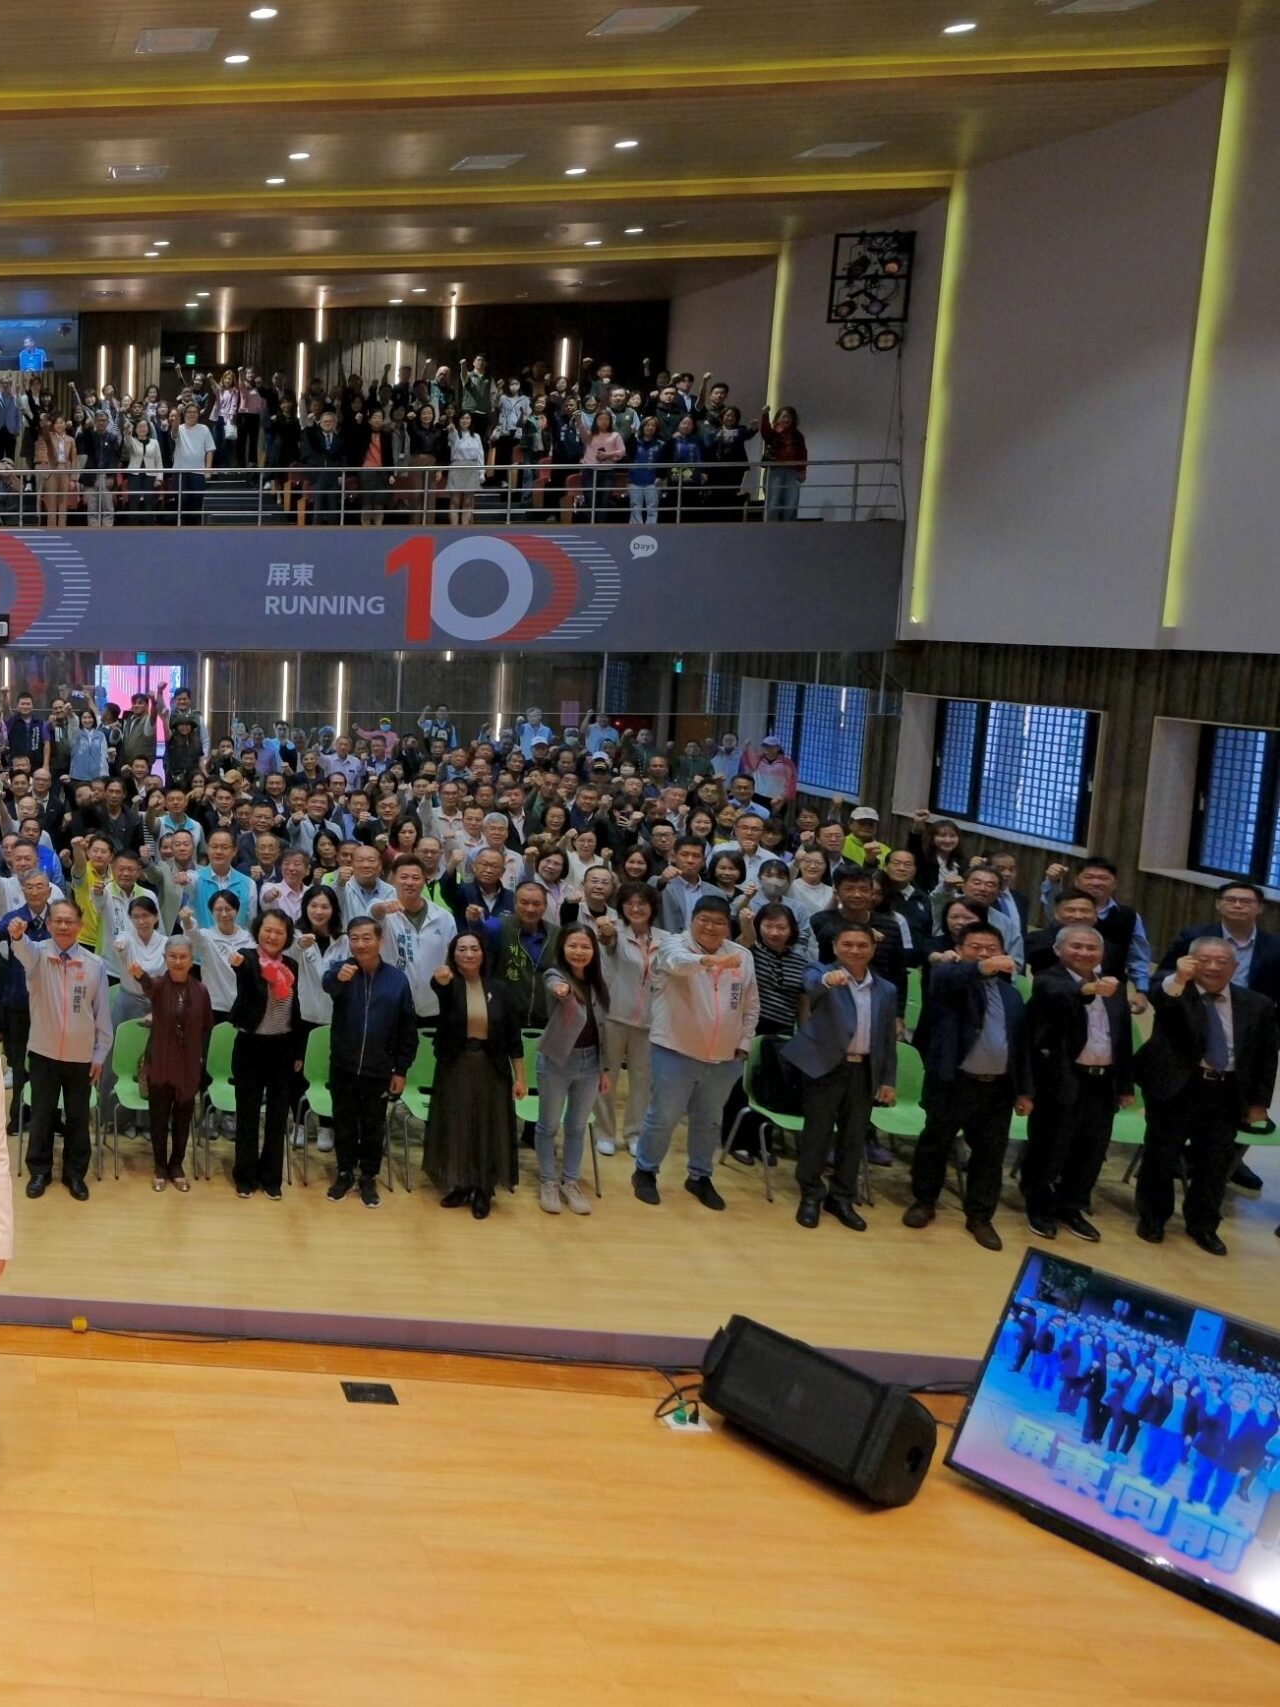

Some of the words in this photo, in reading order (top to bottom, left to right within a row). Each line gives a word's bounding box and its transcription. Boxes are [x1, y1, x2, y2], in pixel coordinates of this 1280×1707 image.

[633, 541, 656, 553] Days
[266, 563, 315, 587] 屏東
[264, 595, 386, 616] RUNNING
[1008, 1414, 1254, 1573] 屏東向前
